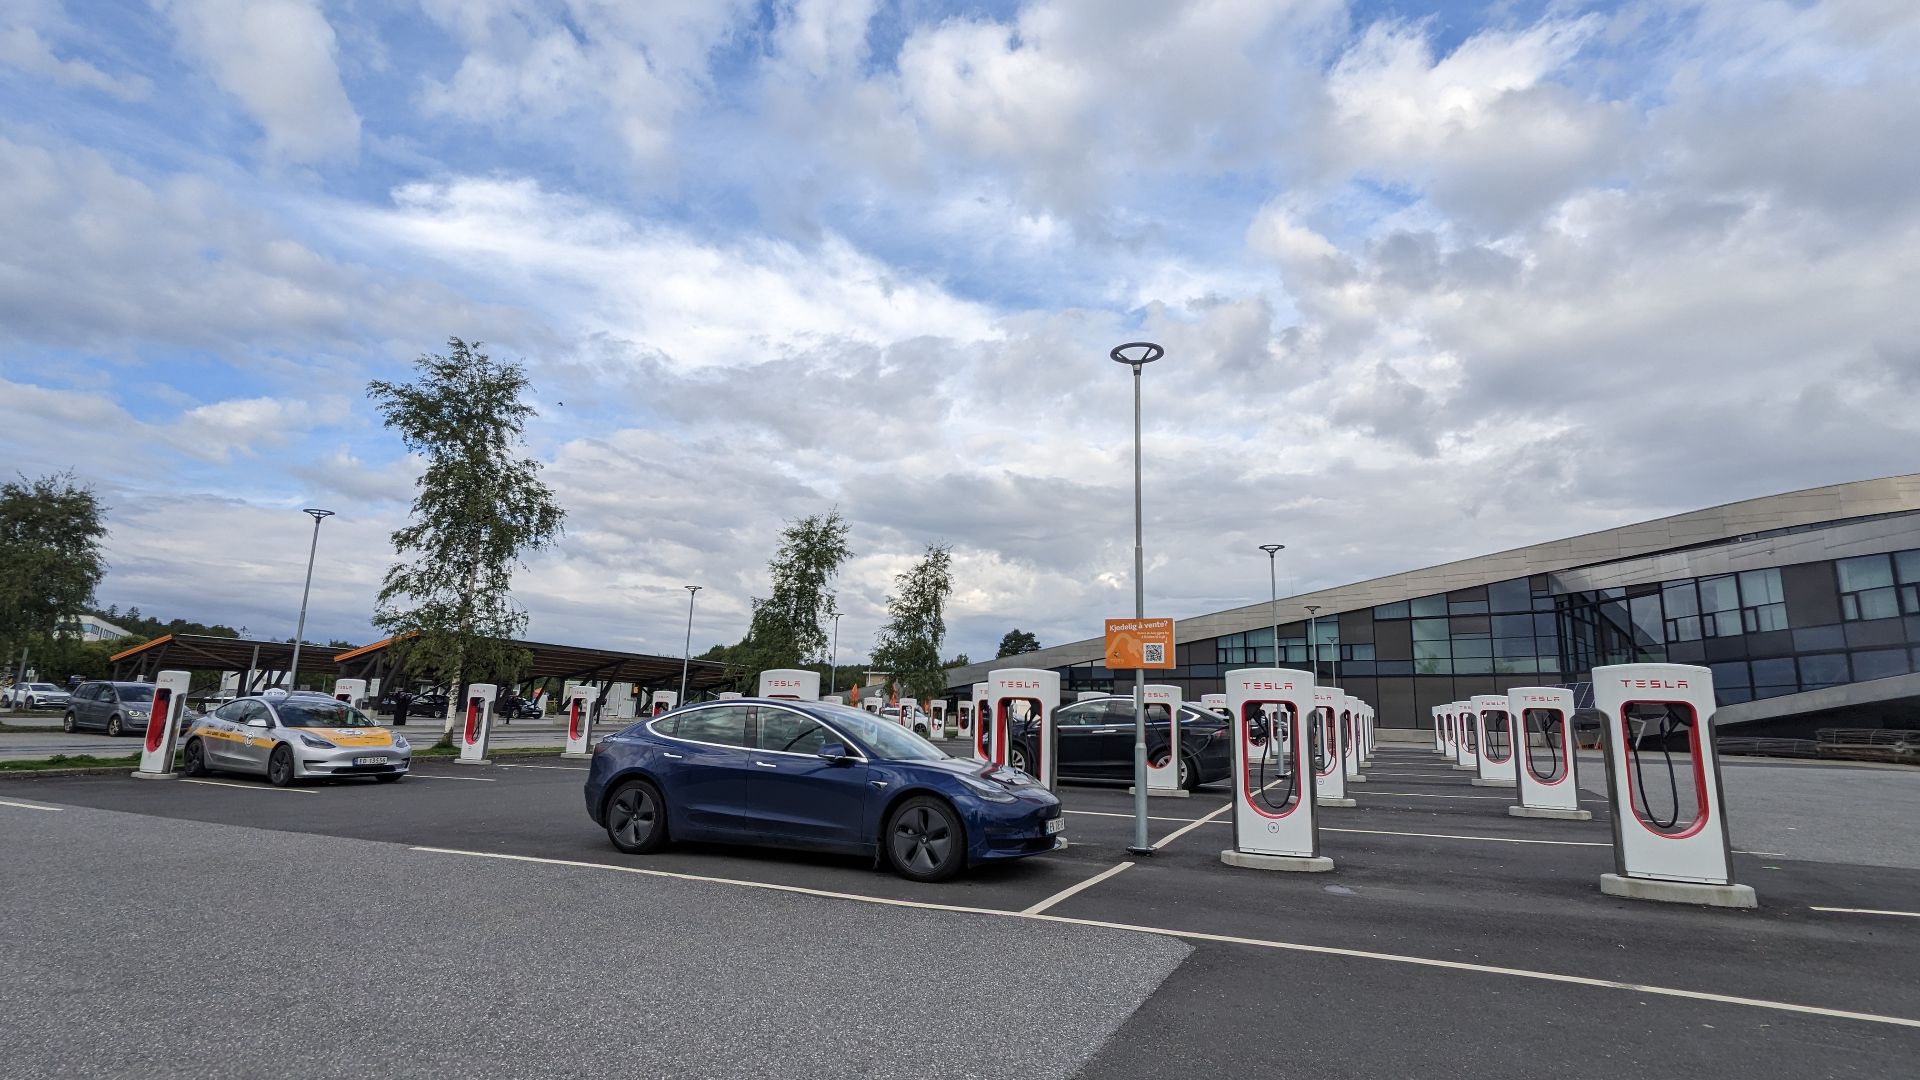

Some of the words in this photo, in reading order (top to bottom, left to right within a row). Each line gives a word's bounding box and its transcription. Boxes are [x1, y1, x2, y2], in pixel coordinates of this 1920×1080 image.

[1109, 622, 1137, 632] Kjedelig
[1138, 621, 1143, 629] å
[1144, 620, 1168, 629] vente?
[1243, 682, 1293, 690] TESLA
[1620, 679, 1688, 689] TESLA
